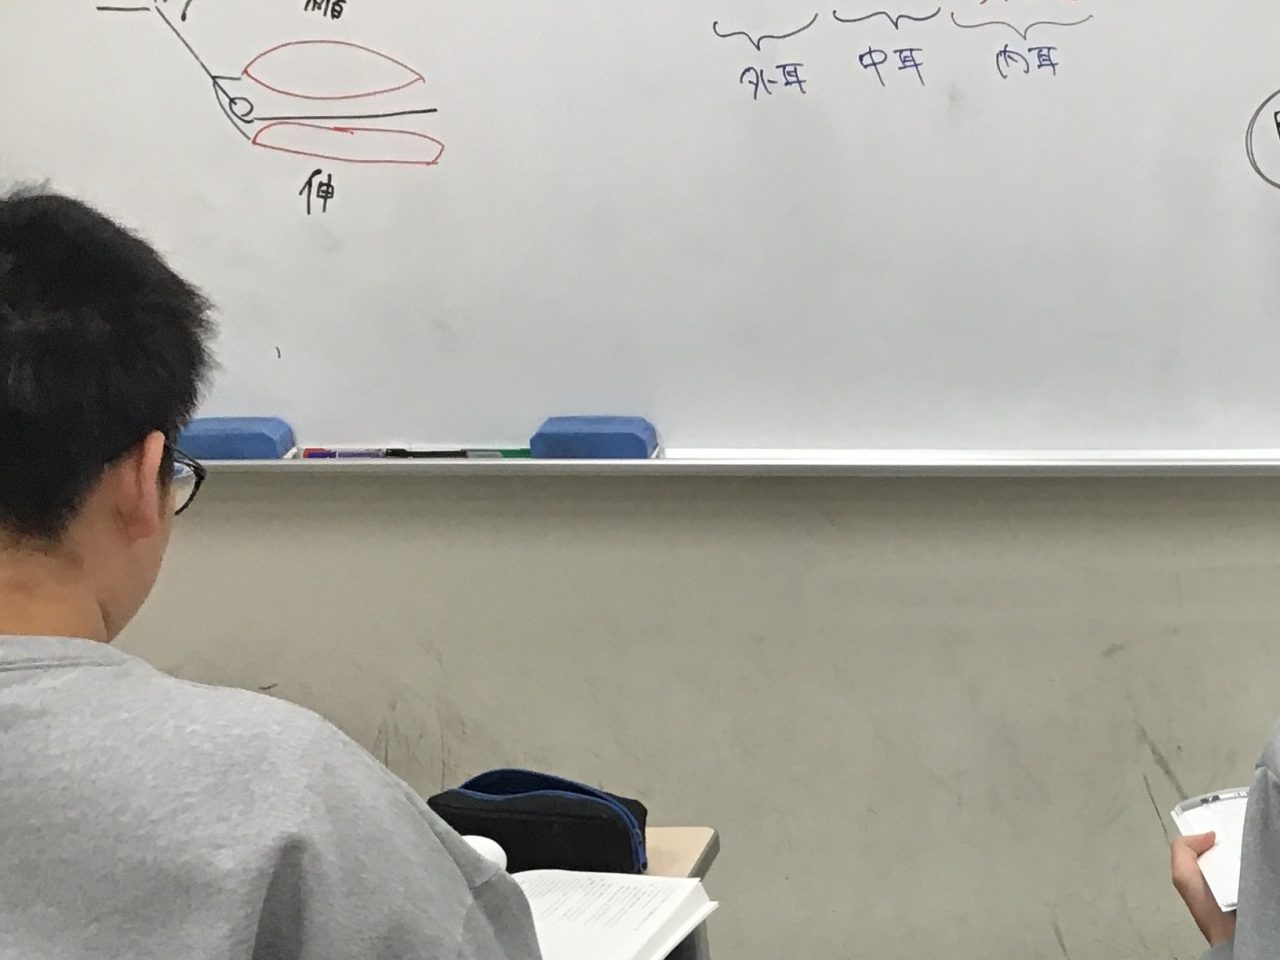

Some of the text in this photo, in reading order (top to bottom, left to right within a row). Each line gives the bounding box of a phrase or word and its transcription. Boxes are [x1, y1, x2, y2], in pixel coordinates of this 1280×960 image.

[859, 45, 924, 86] 中耳
[995, 43, 1060, 77] 内耳
[739, 61, 807, 99] 外耳
[299, 169, 336, 214] 伸
